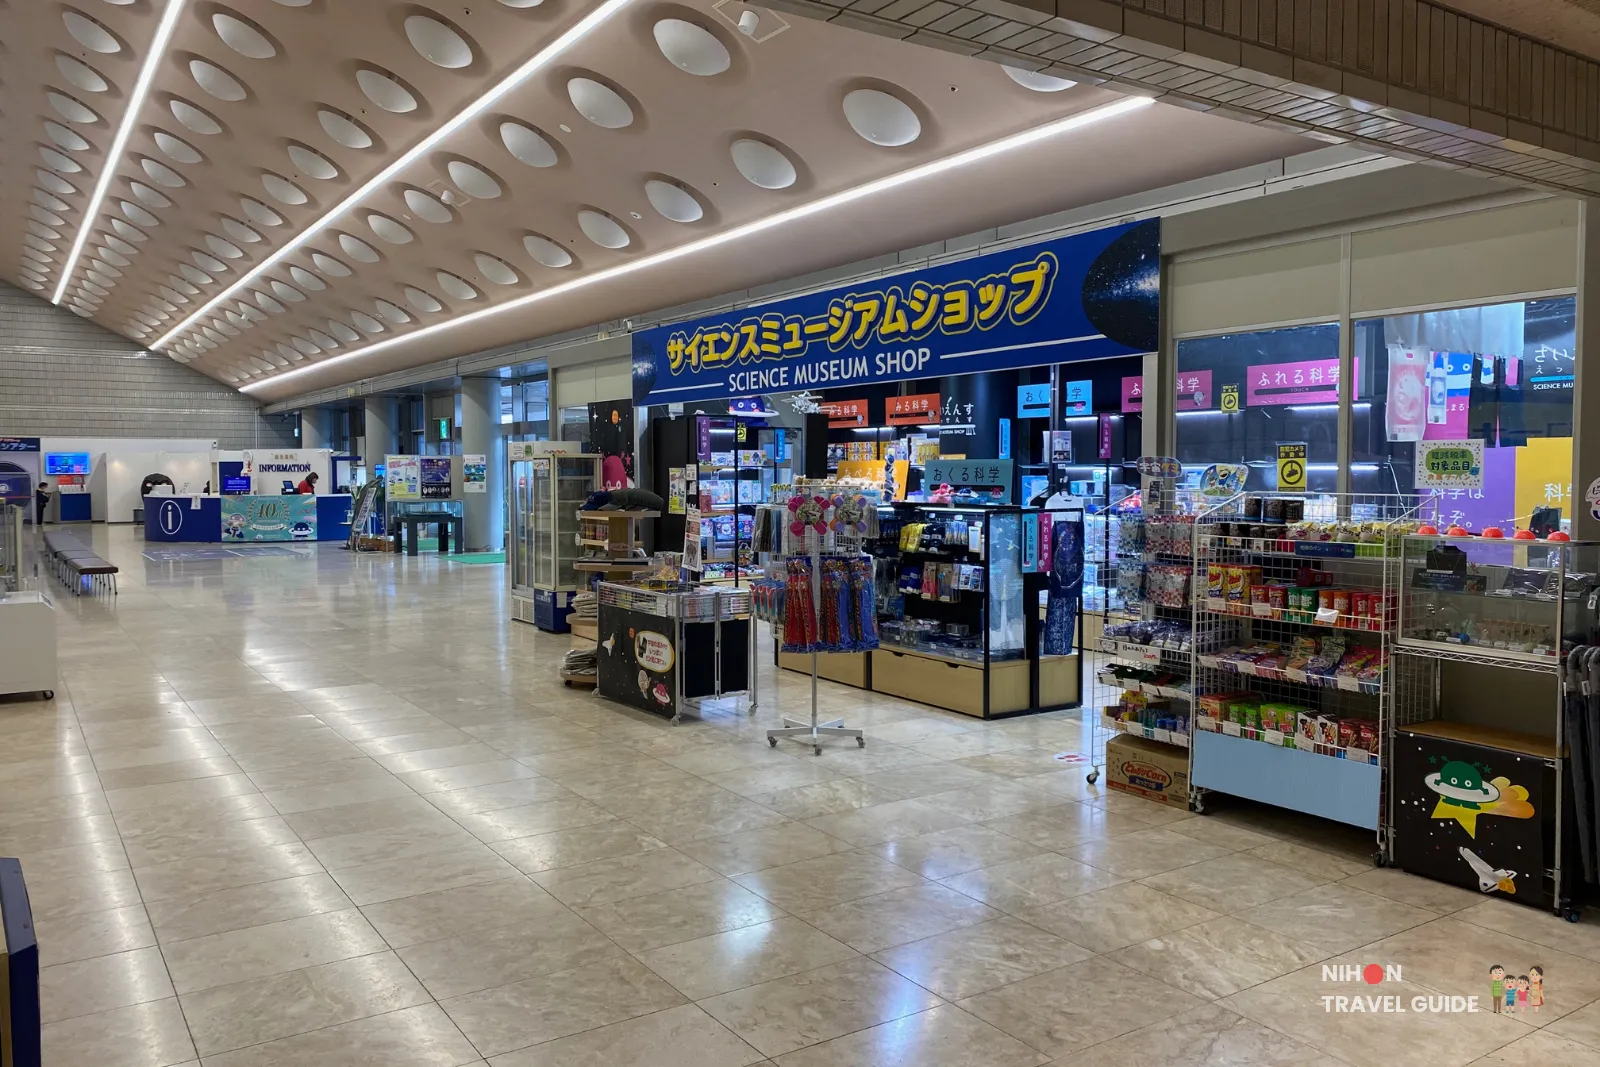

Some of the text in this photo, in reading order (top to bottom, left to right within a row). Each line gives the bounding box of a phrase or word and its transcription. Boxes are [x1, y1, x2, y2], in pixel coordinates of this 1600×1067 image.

[666, 252, 1059, 377] サイエンスミュージアムショップ
[728, 348, 931, 392] SCIENCE MUSEUM SHOP
[1258, 366, 1340, 386] ふれる科学
[895, 399, 929, 412] みる科学
[259, 463, 311, 472] INFORMATION
[1431, 460, 1470, 471] 対象品目
[933, 466, 1000, 483] おくる科学
